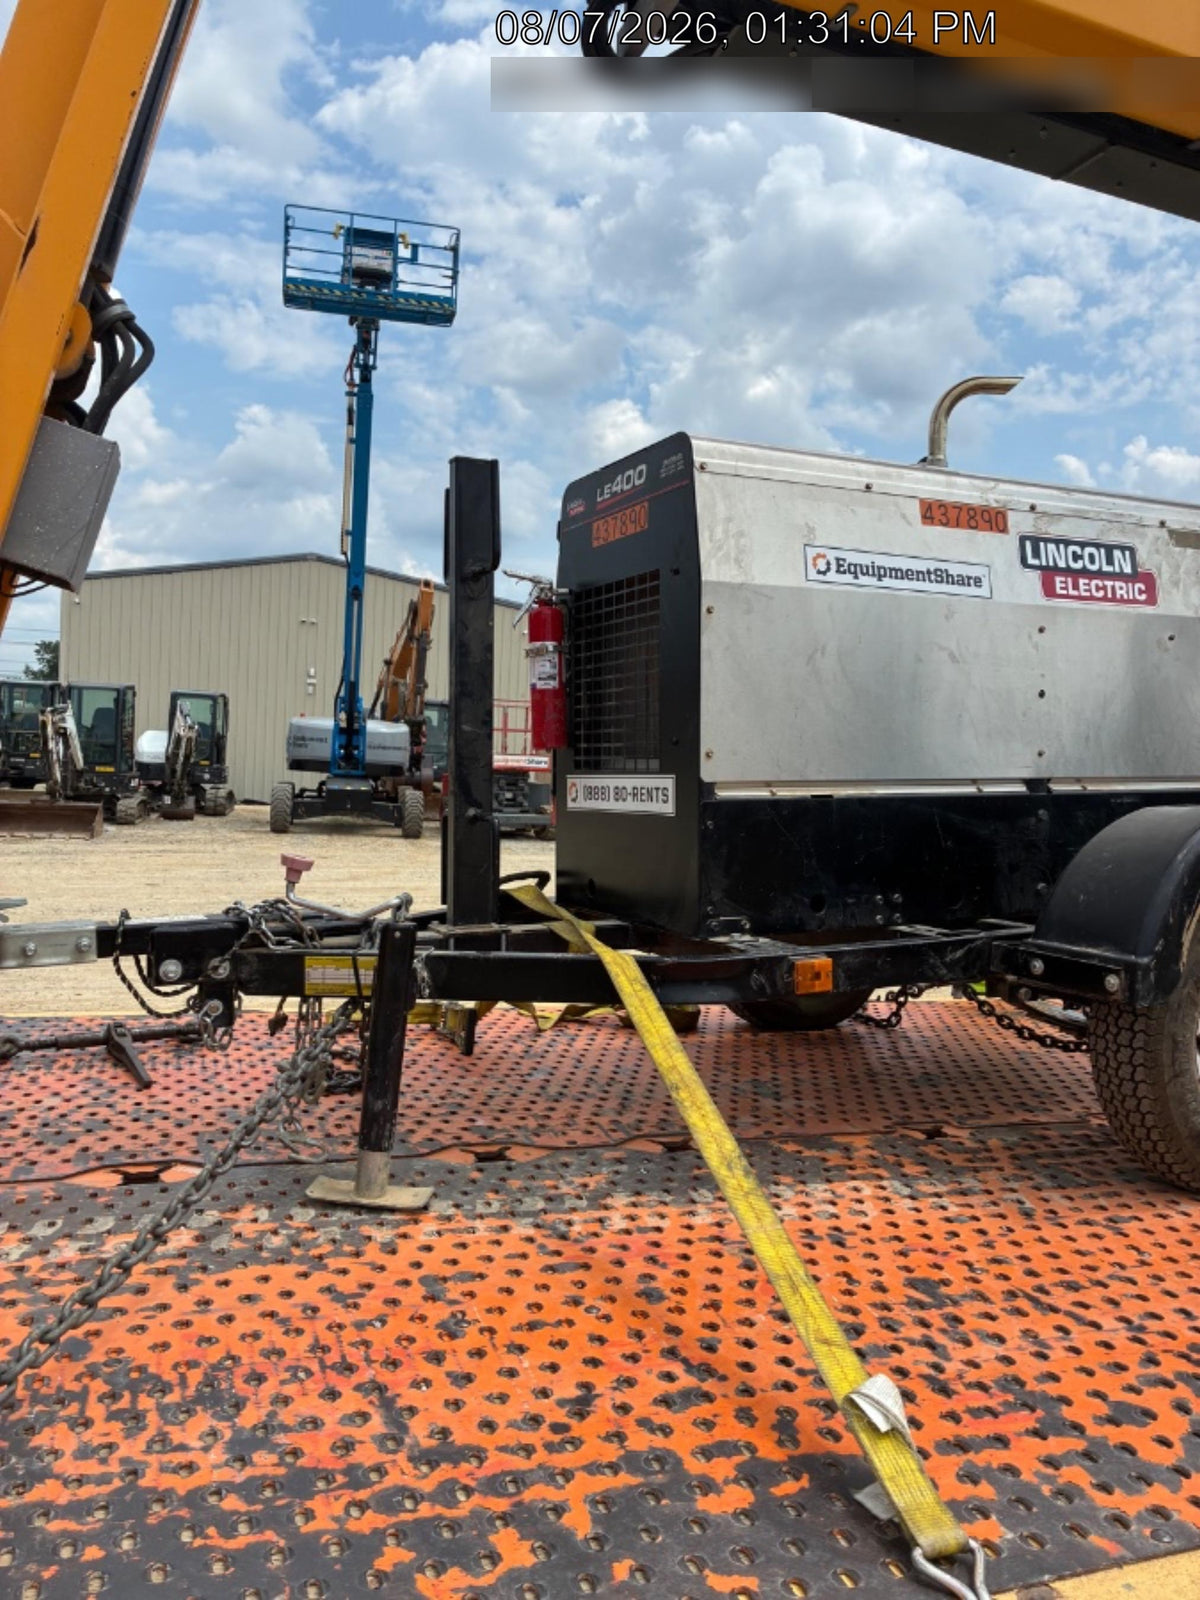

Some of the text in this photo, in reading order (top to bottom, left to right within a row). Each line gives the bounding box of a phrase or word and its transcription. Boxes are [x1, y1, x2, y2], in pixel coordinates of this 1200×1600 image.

[596, 463, 647, 502] LE400
[592, 505, 648, 545] 437890
[923, 502, 1007, 533] 437890
[834, 556, 984, 588] EquipmentShare
[1025, 540, 1132, 574] LINCOLN
[1054, 575, 1148, 601] ELECTRIC
[582, 784, 670, 804] (888) 80-RENTS
